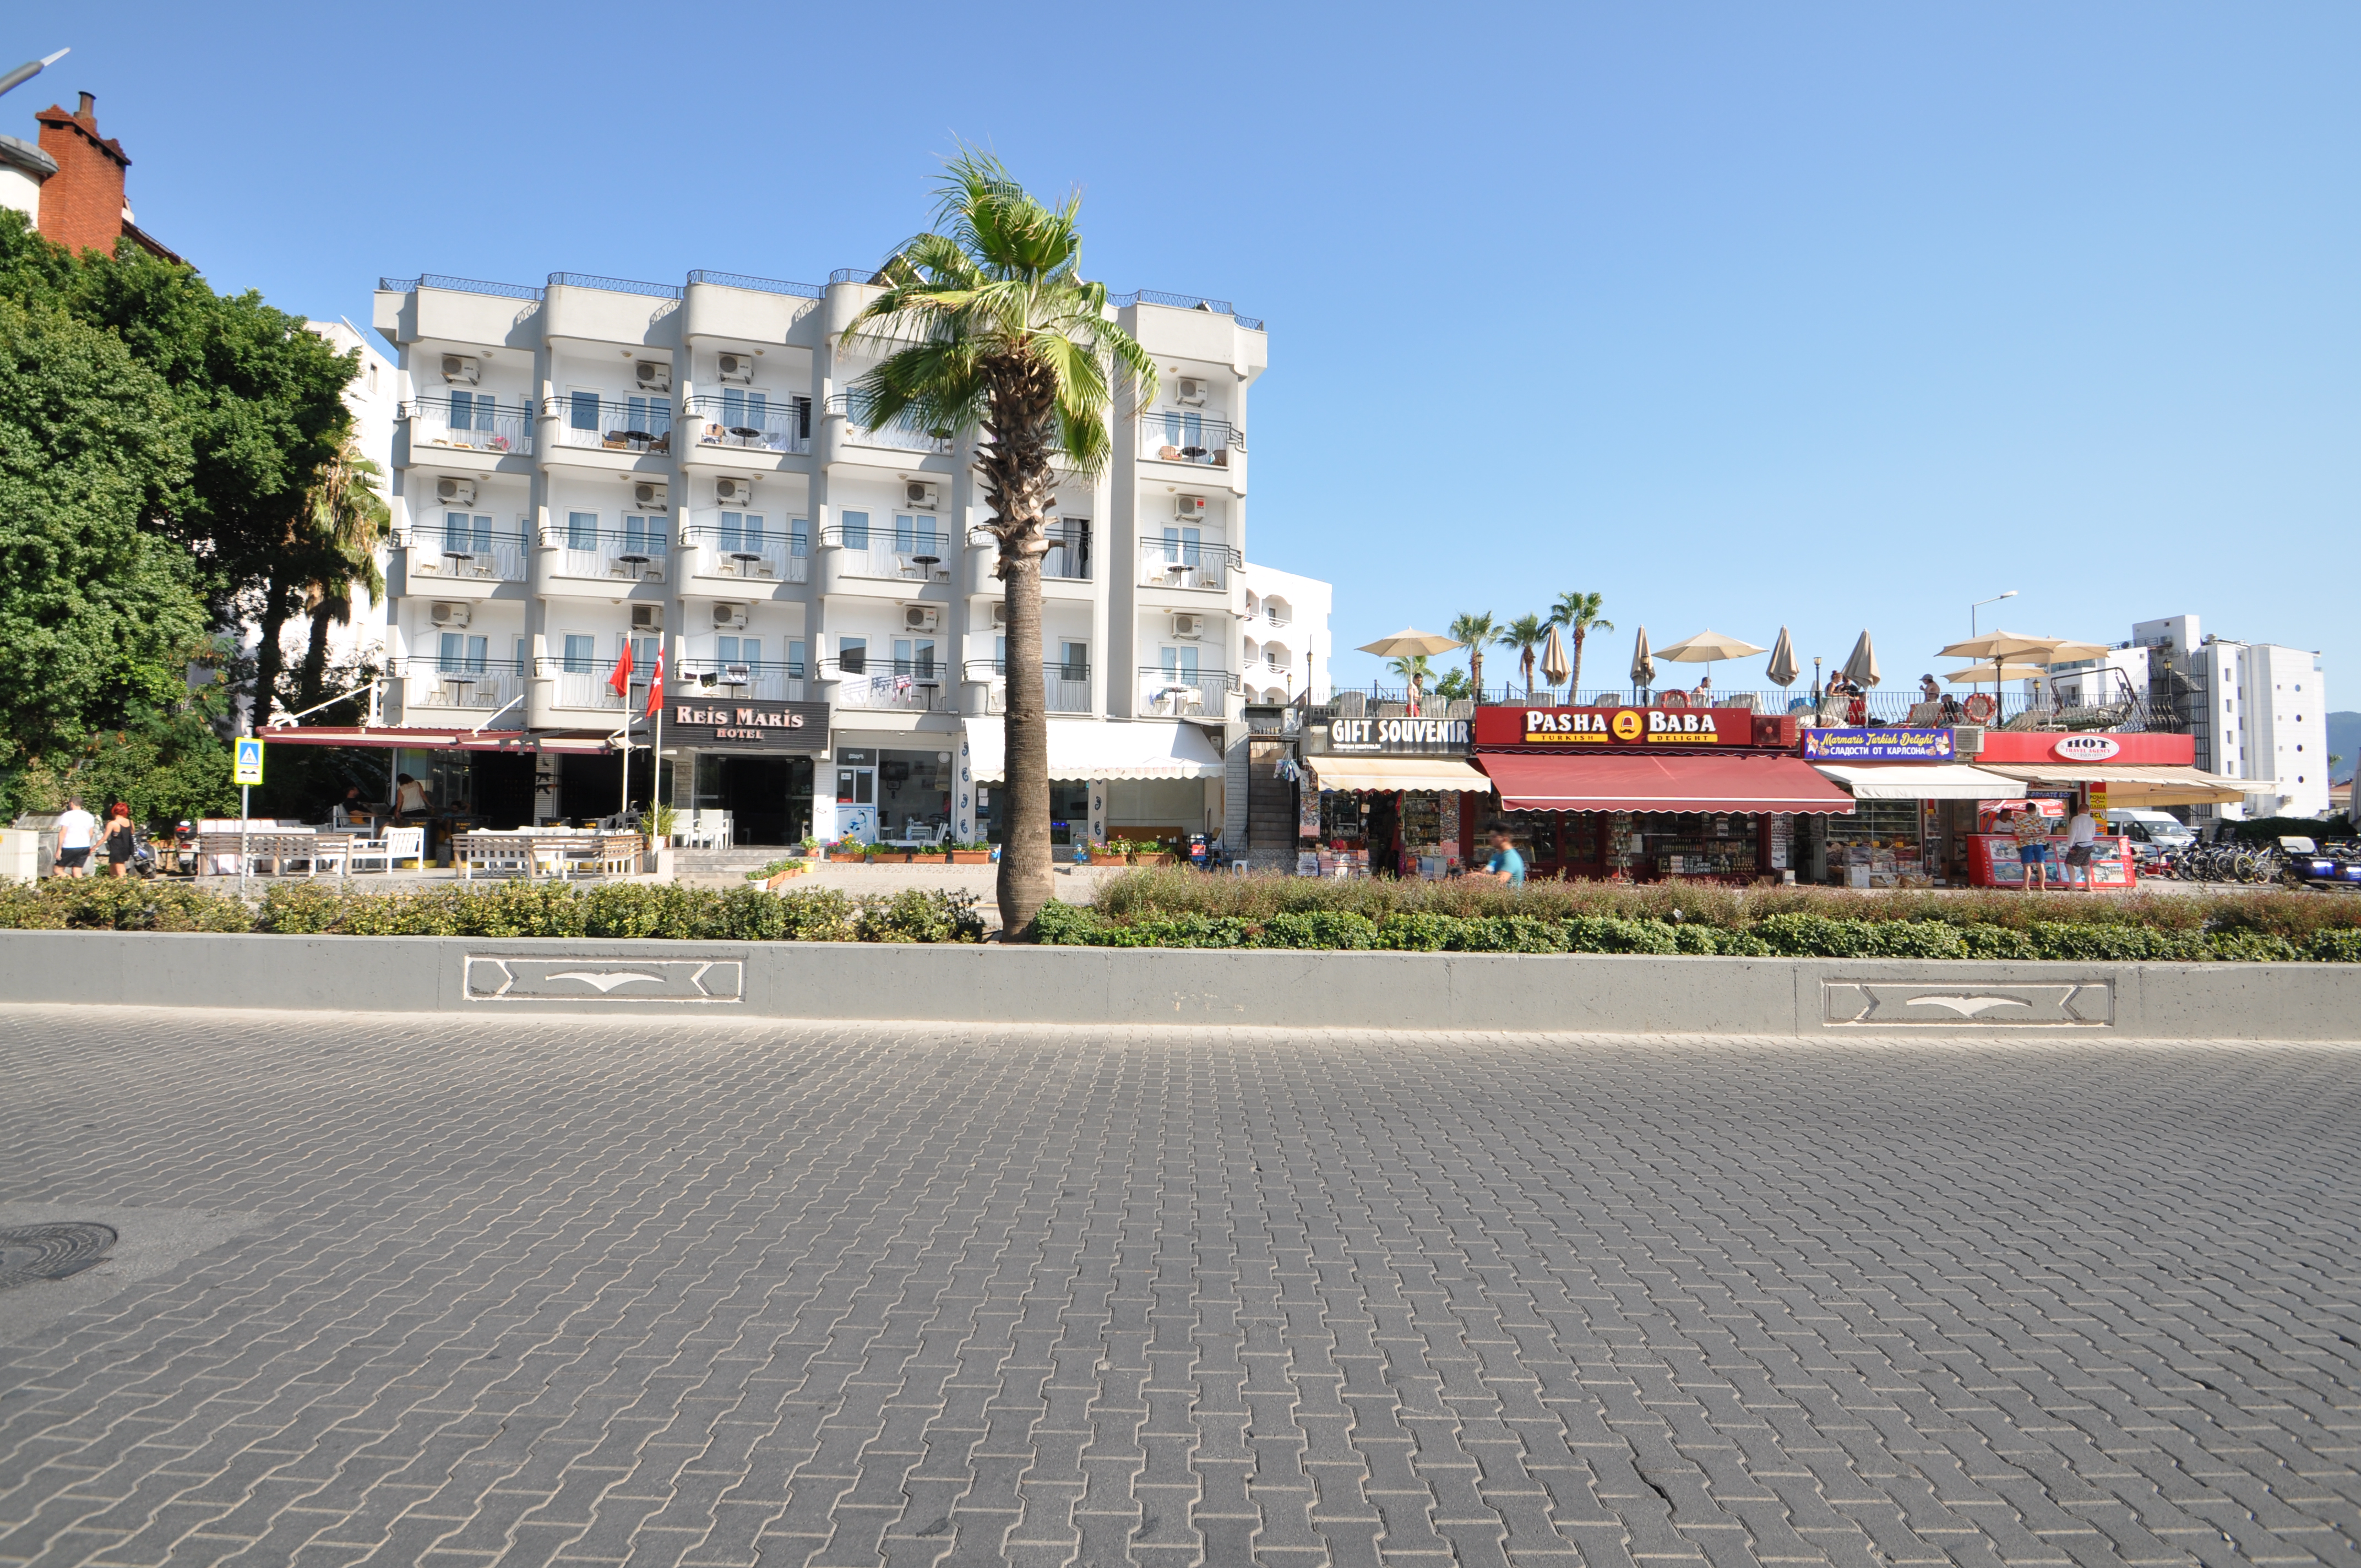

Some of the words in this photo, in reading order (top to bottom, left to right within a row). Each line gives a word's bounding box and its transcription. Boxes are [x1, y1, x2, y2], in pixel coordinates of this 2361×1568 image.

[1526, 711, 1607, 732] PASHA
[1648, 711, 1716, 732] BABA
[716, 729, 764, 739] HOTEL
[1332, 720, 1372, 742] GIFT
[1378, 720, 1469, 743] SOUVENIR
[1821, 733, 1864, 746] Marmaris
[1866, 733, 1898, 746] Turkish
[1900, 732, 1936, 746] Delight
[2067, 739, 2109, 748] HOT
[1830, 747, 1869, 756] СЛАДОСТИ
